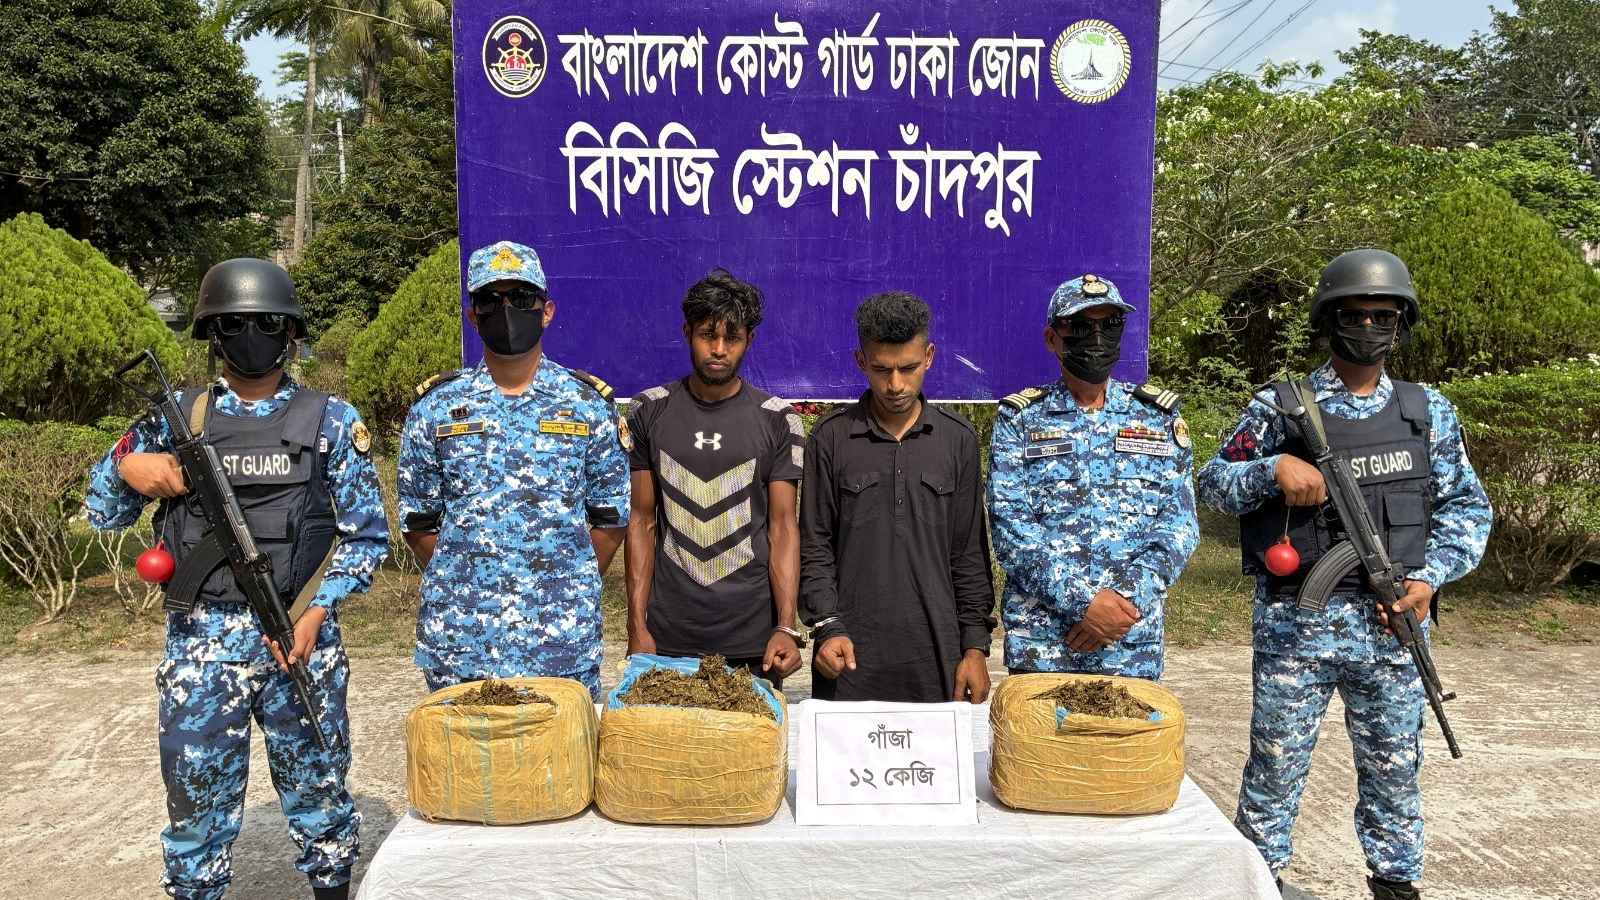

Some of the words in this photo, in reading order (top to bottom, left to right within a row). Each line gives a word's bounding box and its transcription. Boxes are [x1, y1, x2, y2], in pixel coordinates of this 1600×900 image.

[557, 27, 709, 102] বাংলাদেশ
[716, 12, 809, 97] কোস্ট
[818, 12, 881, 98] গার্ড
[886, 31, 961, 99] ঢাকা
[969, 31, 1046, 100] জোন
[559, 121, 720, 218] বিসিজি
[732, 122, 880, 220] স্টেশন
[887, 122, 1042, 237] চাঁদপুর
[223, 454, 240, 476] ST
[241, 453, 291, 476] GUARD
[1350, 456, 1367, 478] ST
[1370, 450, 1413, 476] GUARD
[867, 723, 913, 749] গাঁজা
[849, 767, 878, 789] ১২
[884, 760, 936, 786] কেজি
